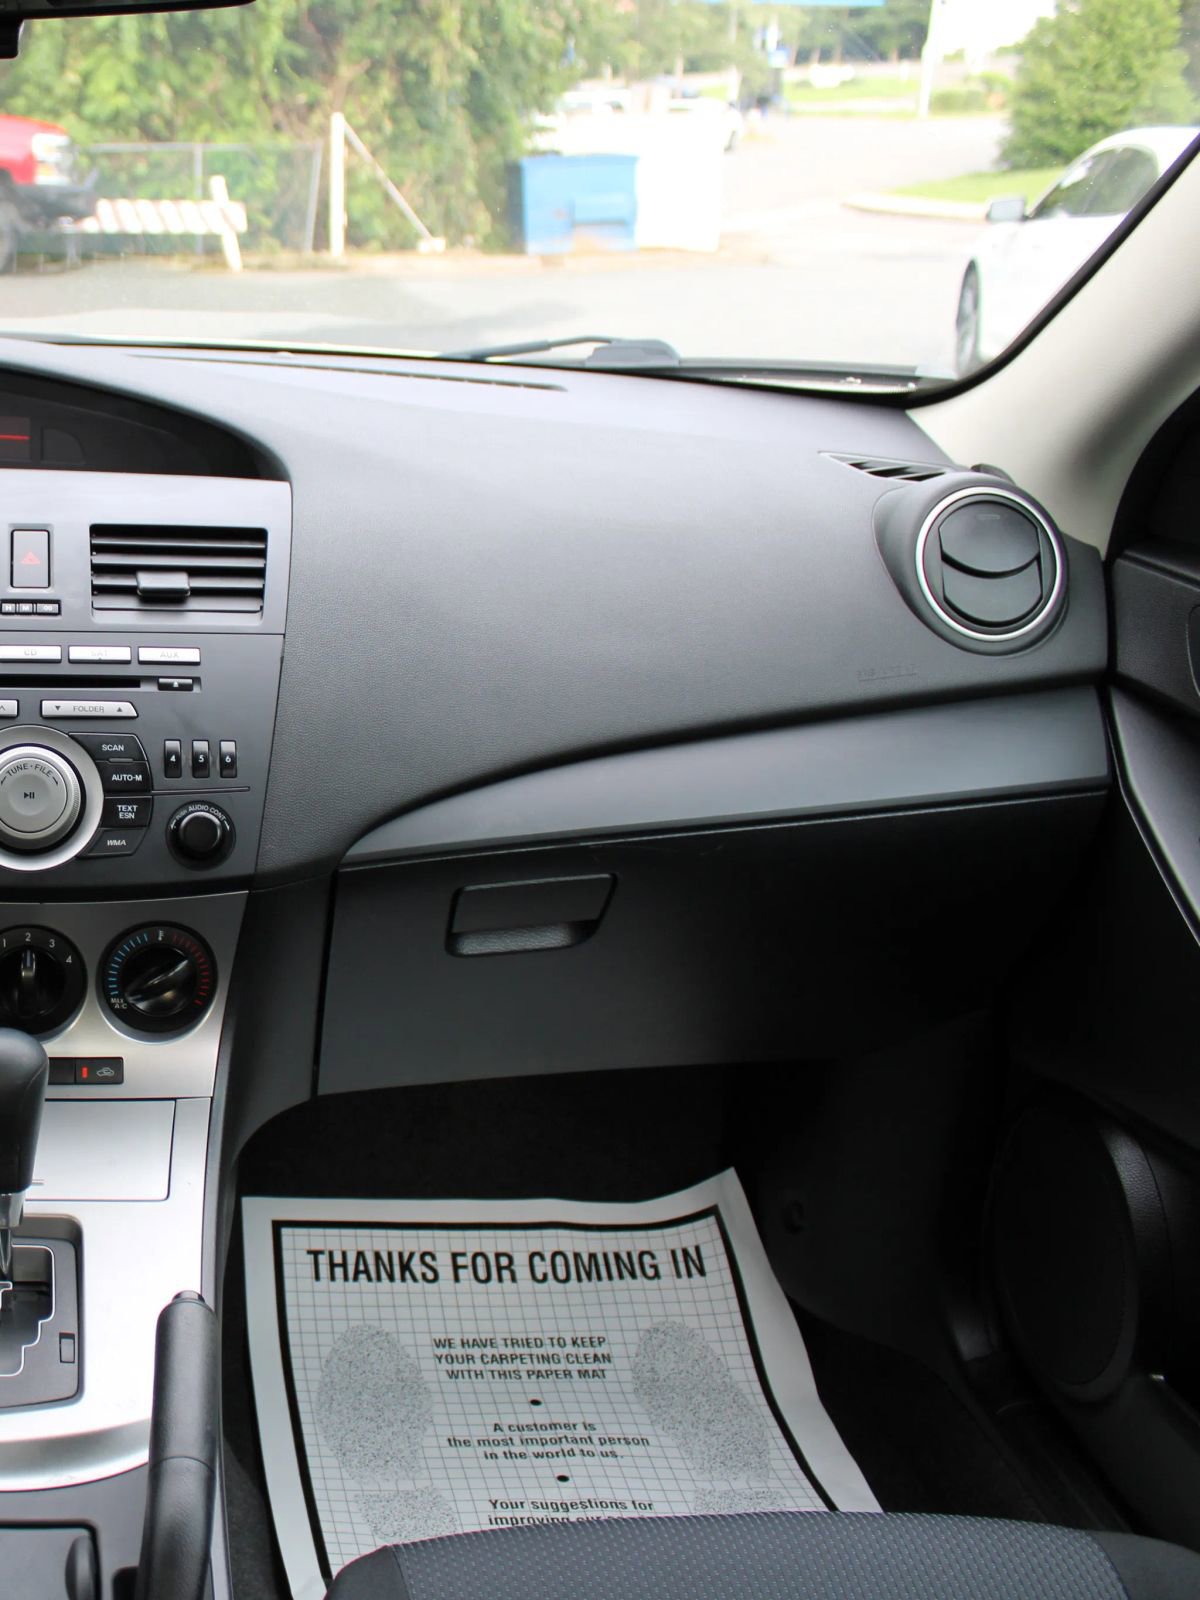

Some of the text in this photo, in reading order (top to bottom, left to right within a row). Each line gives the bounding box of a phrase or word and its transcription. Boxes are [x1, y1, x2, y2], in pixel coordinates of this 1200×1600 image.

[24, 649, 38, 657] CD
[159, 650, 180, 659] AUX
[72, 705, 105, 714] FOLDER
[101, 744, 125, 752] SCAN
[169, 754, 177, 763] 4
[197, 754, 205, 763] 5
[224, 754, 232, 763] 6
[111, 774, 143, 782] AUTO-M
[117, 804, 138, 812] TEXT
[188, 804, 209, 812] AUDIO
[209, 806, 226, 822] CONT
[24, 932, 32, 942] 2
[48, 938, 56, 948] 3
[65, 955, 73, 965] 4
[306, 1244, 708, 1285] THANKS FOR COMING IN
[433, 1336, 606, 1349] WE HAVE TRIED TO KEEP
[434, 1353, 612, 1365] YOUR CARPETING CLEAN
[446, 1369, 607, 1380] WITH THIS PAPER MAT
[492, 1420, 597, 1433] A customer is
[447, 1434, 650, 1448] the most important person
[484, 1448, 624, 1460] in the world to us.
[489, 1498, 653, 1513] Your suggestions for
